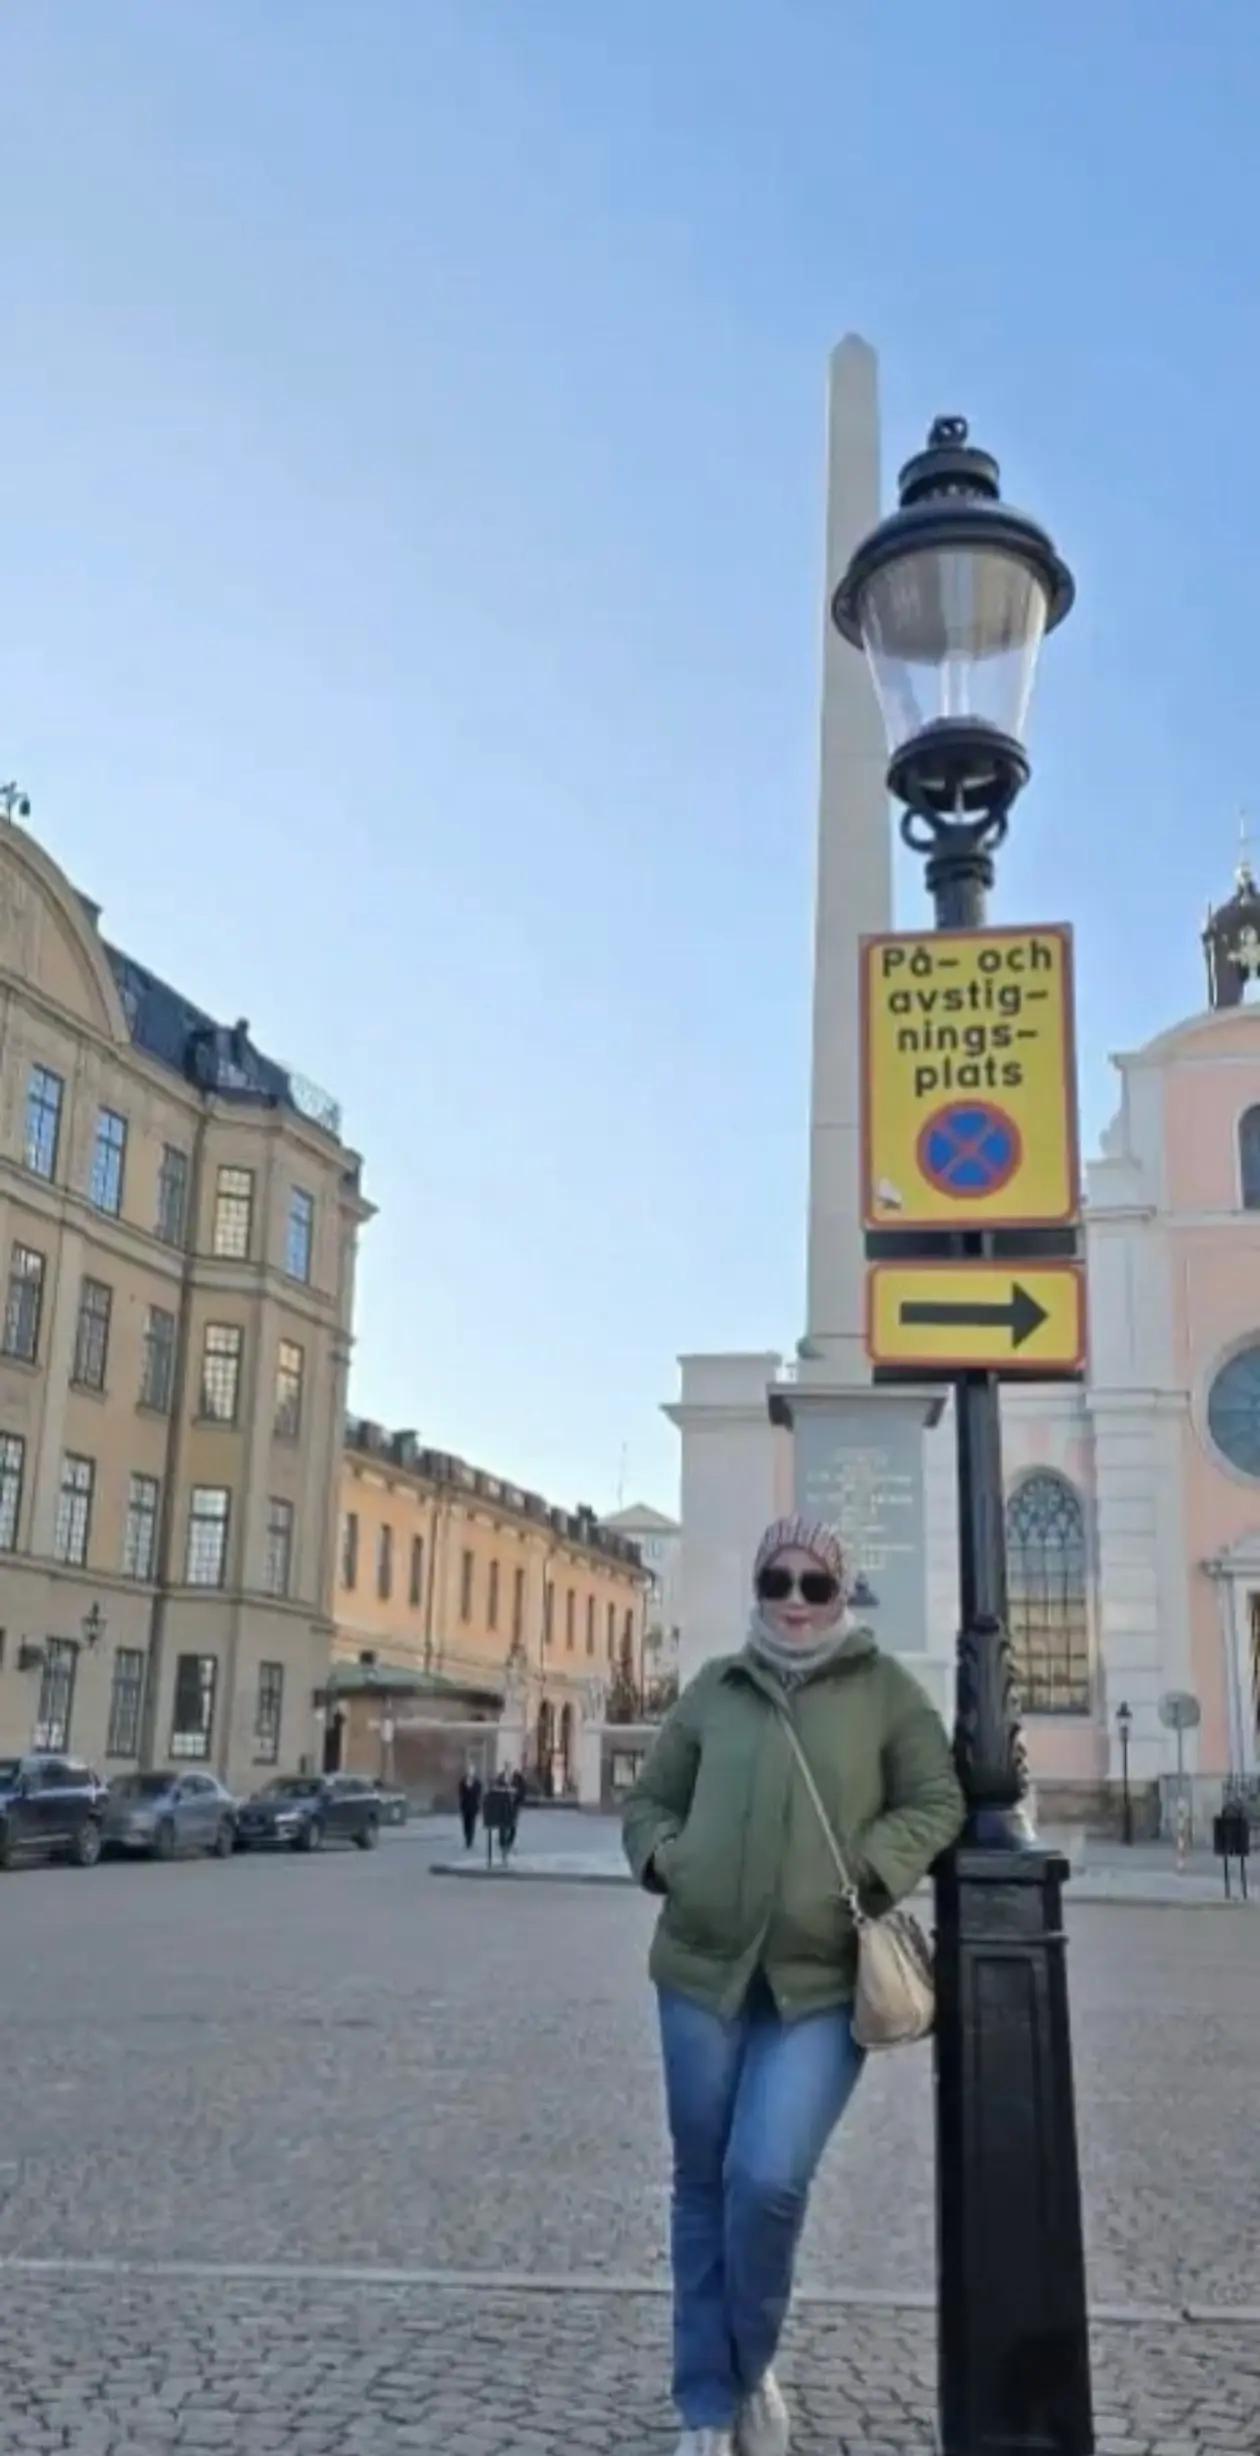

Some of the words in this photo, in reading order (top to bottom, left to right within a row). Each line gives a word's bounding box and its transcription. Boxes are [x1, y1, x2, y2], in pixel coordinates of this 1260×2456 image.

[882, 945, 959, 977] På-
[977, 939, 1052, 972] och
[888, 978, 1048, 1016] avstig-
[898, 1019, 1038, 1057] nings-
[915, 1055, 1022, 1097] plats
